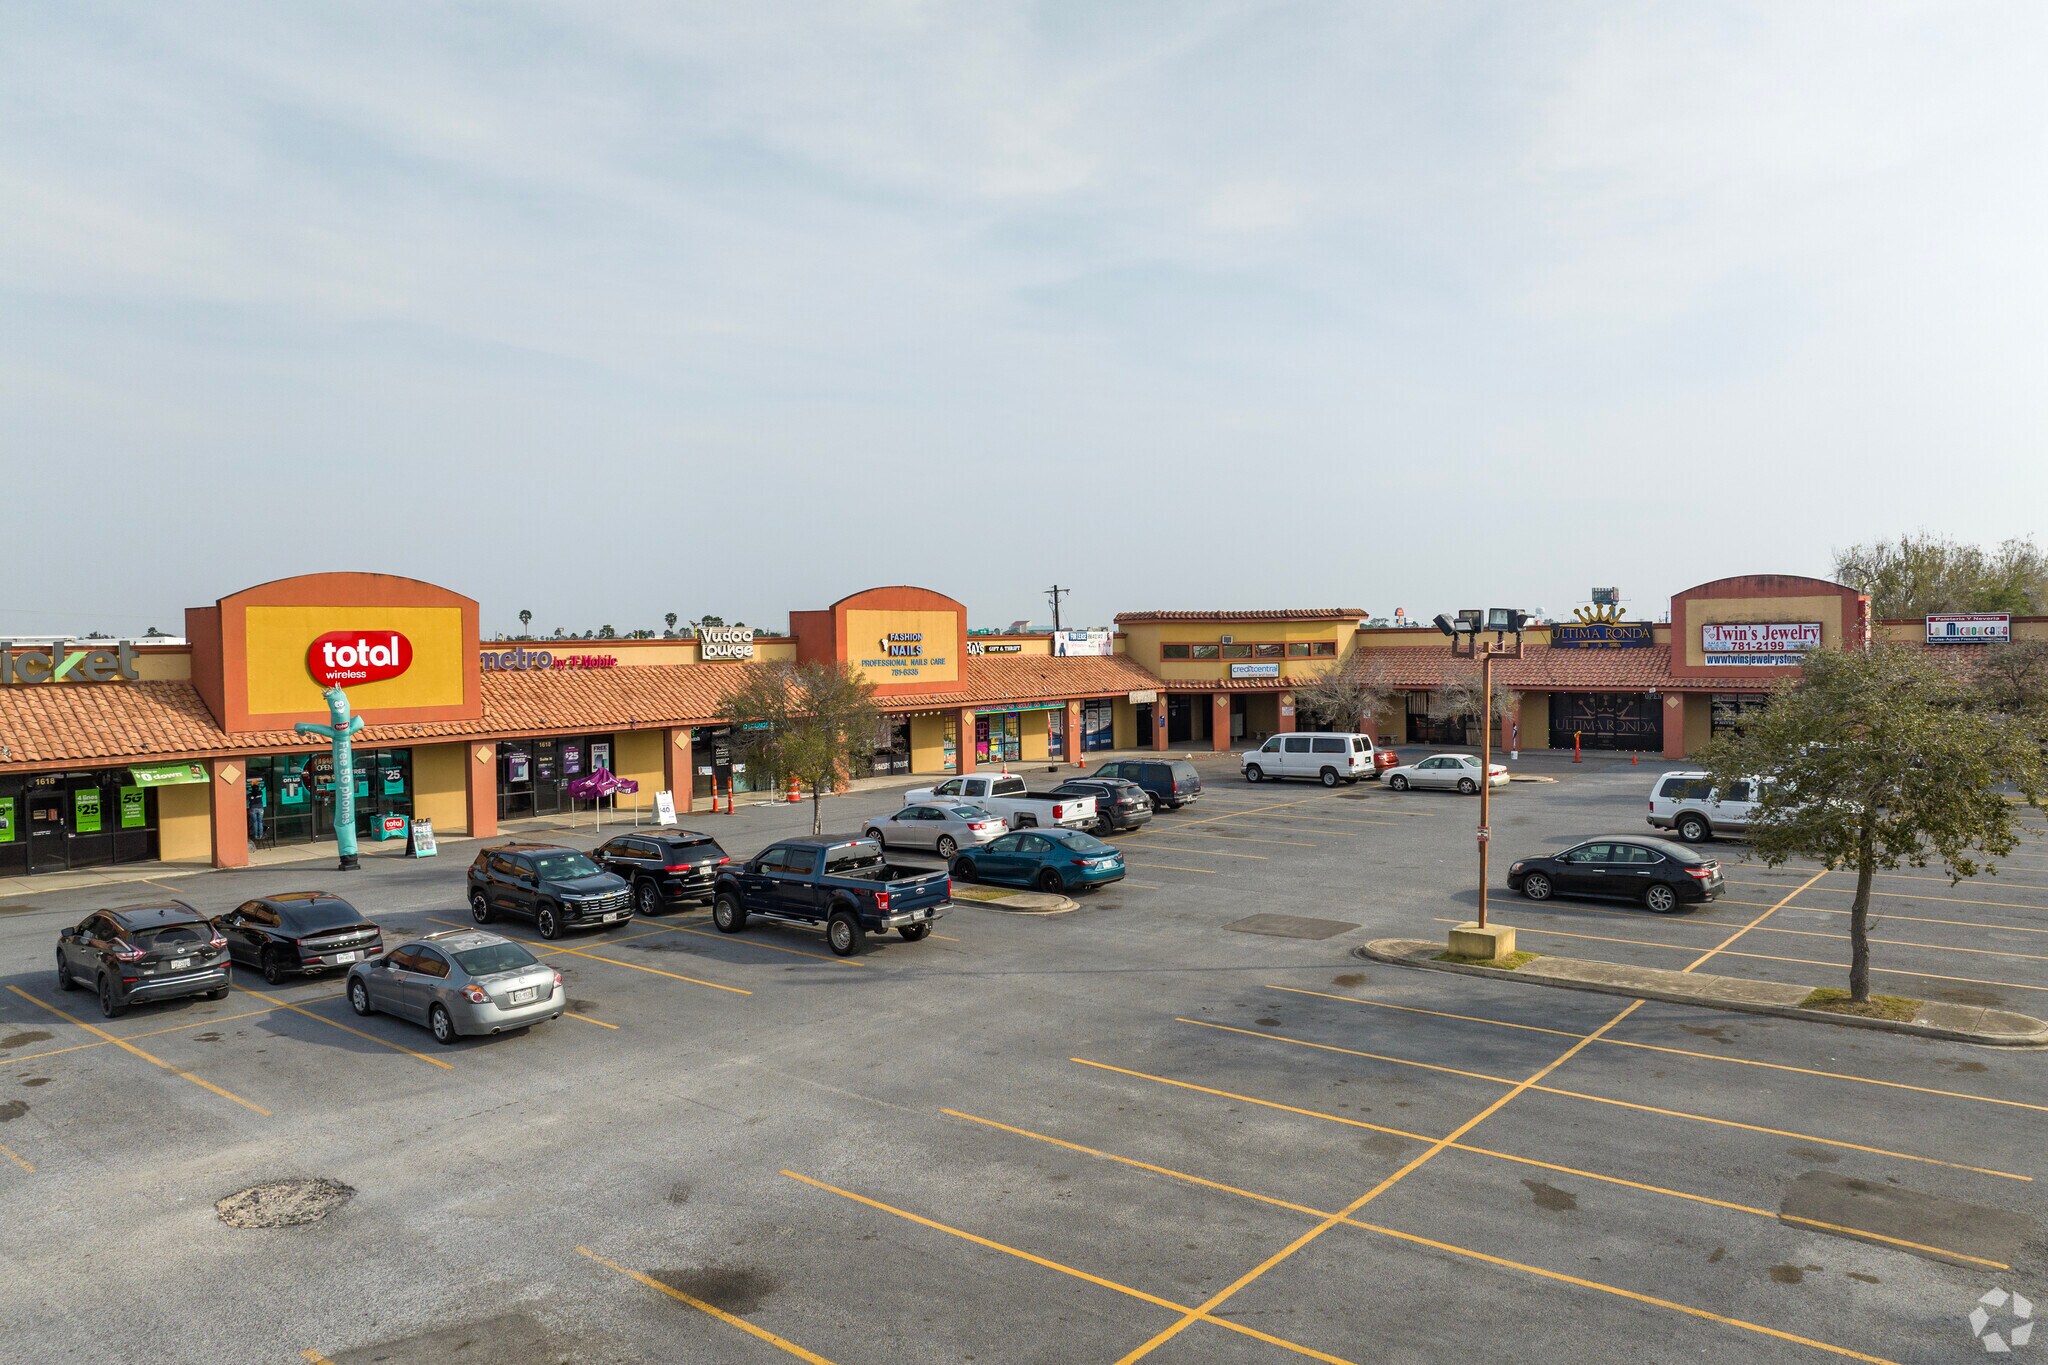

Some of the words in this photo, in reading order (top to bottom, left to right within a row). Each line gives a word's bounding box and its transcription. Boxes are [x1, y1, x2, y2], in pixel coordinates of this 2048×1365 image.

[701, 627, 753, 643] Vudoo
[889, 633, 923, 641] FASHION
[1605, 627, 1651, 640] RONDA
[1713, 625, 1758, 641] Twin's
[1762, 625, 1819, 644] Jewelry
[322, 635, 399, 668] total
[891, 645, 923, 656] NAILS
[1731, 641, 1785, 651] 781-2199
[702, 644, 754, 660] Lounge
[0, 640, 140, 684] icket
[480, 646, 553, 671] metro
[553, 656, 567, 670] by
[861, 659, 908, 667] PROFESSIONAL
[910, 658, 928, 666] NAILS
[930, 657, 946, 665] CARE
[325, 669, 367, 679] wireless
[338, 741, 349, 767] Free
[565, 752, 579, 760] $25
[153, 771, 183, 780] down
[35, 777, 56, 786] 1618
[122, 792, 143, 804] 5G
[77, 804, 99, 815] $25
[339, 786, 353, 825] phones
[413, 825, 432, 833] FREE
